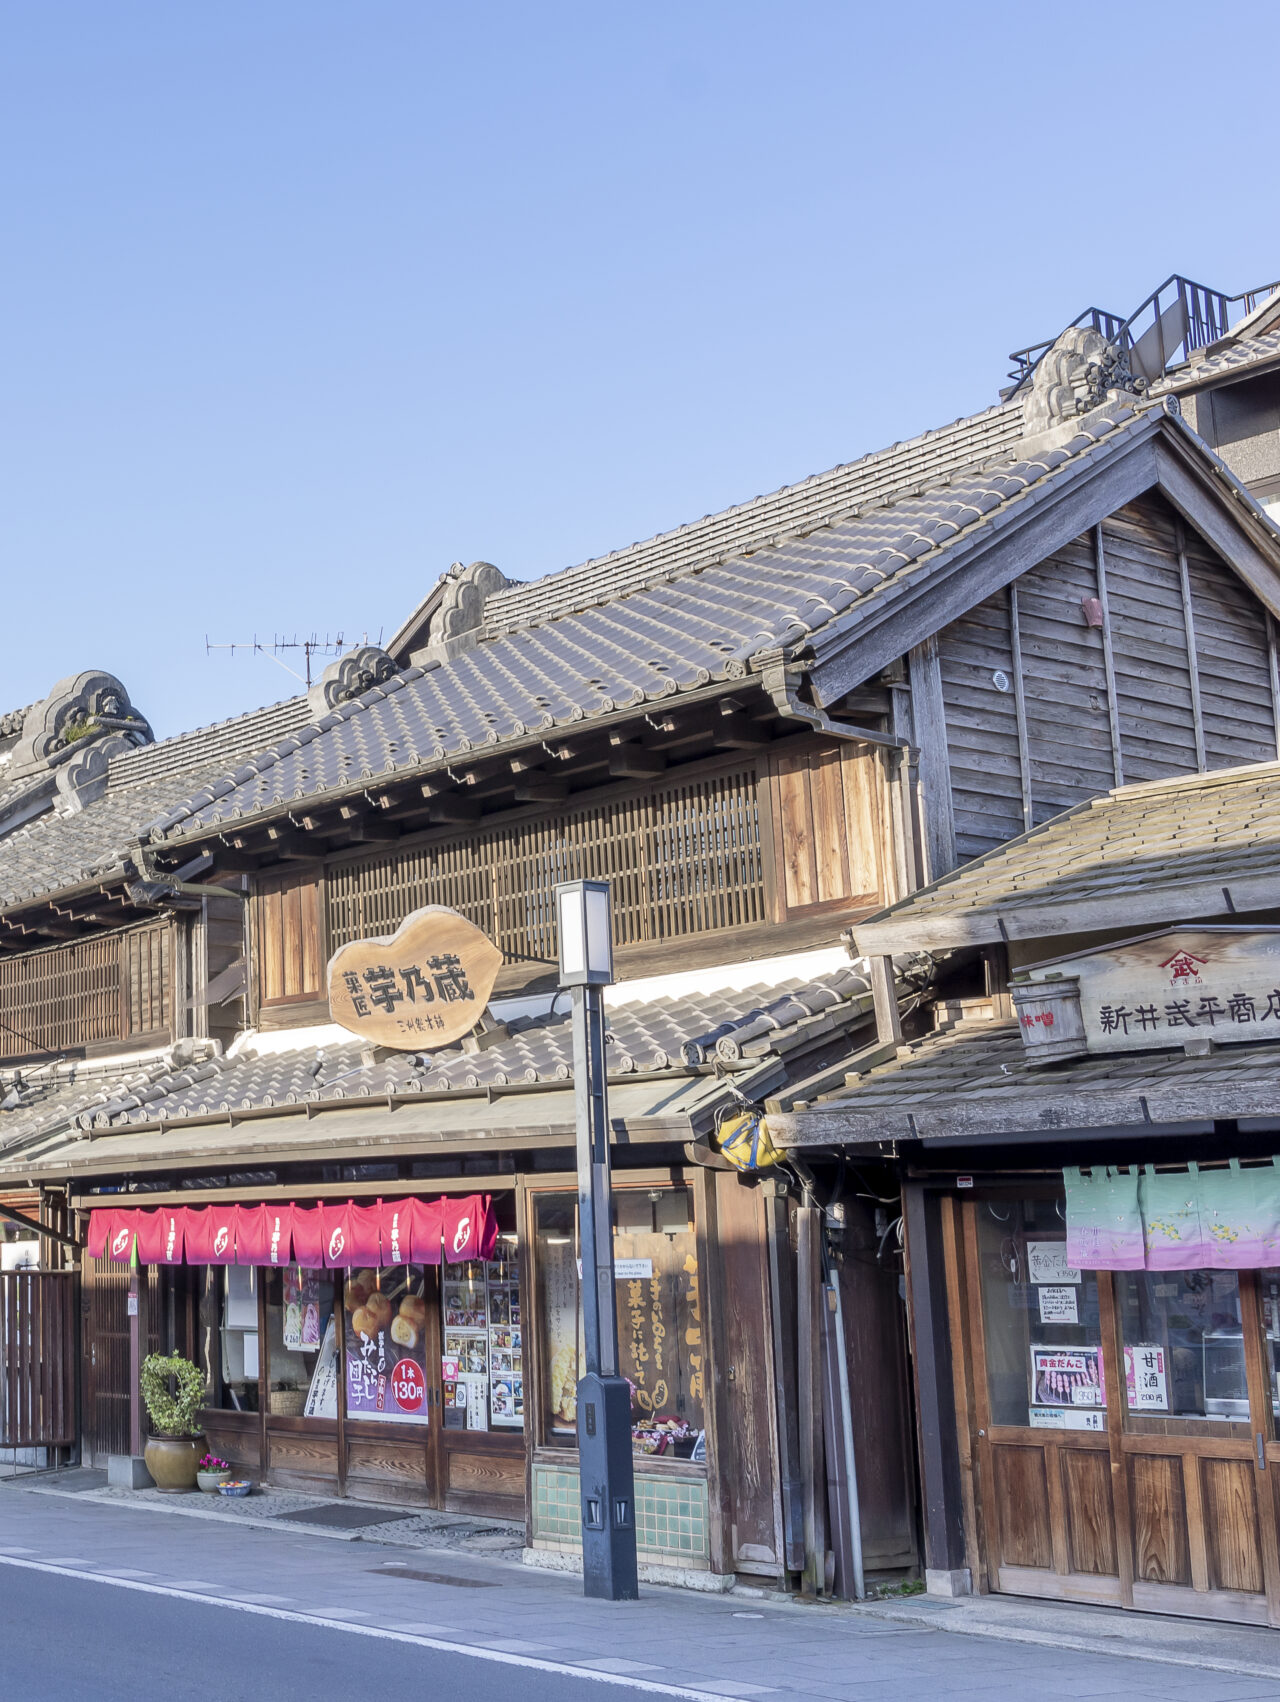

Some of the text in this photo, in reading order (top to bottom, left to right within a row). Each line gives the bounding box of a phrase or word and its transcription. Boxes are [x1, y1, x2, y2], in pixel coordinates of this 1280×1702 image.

[363, 953, 475, 1013] 芋乃蔵
[1170, 957, 1199, 978] 武
[342, 971, 371, 1018] 菓匠
[1100, 989, 1280, 1035] 新井武平商店
[1021, 1011, 1054, 1029] 味噌
[627, 1280, 649, 1385] 菓子に託して
[348, 1359, 366, 1406] 団子
[359, 1331, 378, 1400] みたらし
[400, 1364, 415, 1380] 1本
[1141, 1351, 1159, 1388] 甘酒
[393, 1381, 424, 1400] 130円
[1140, 1393, 1163, 1403] 200円
